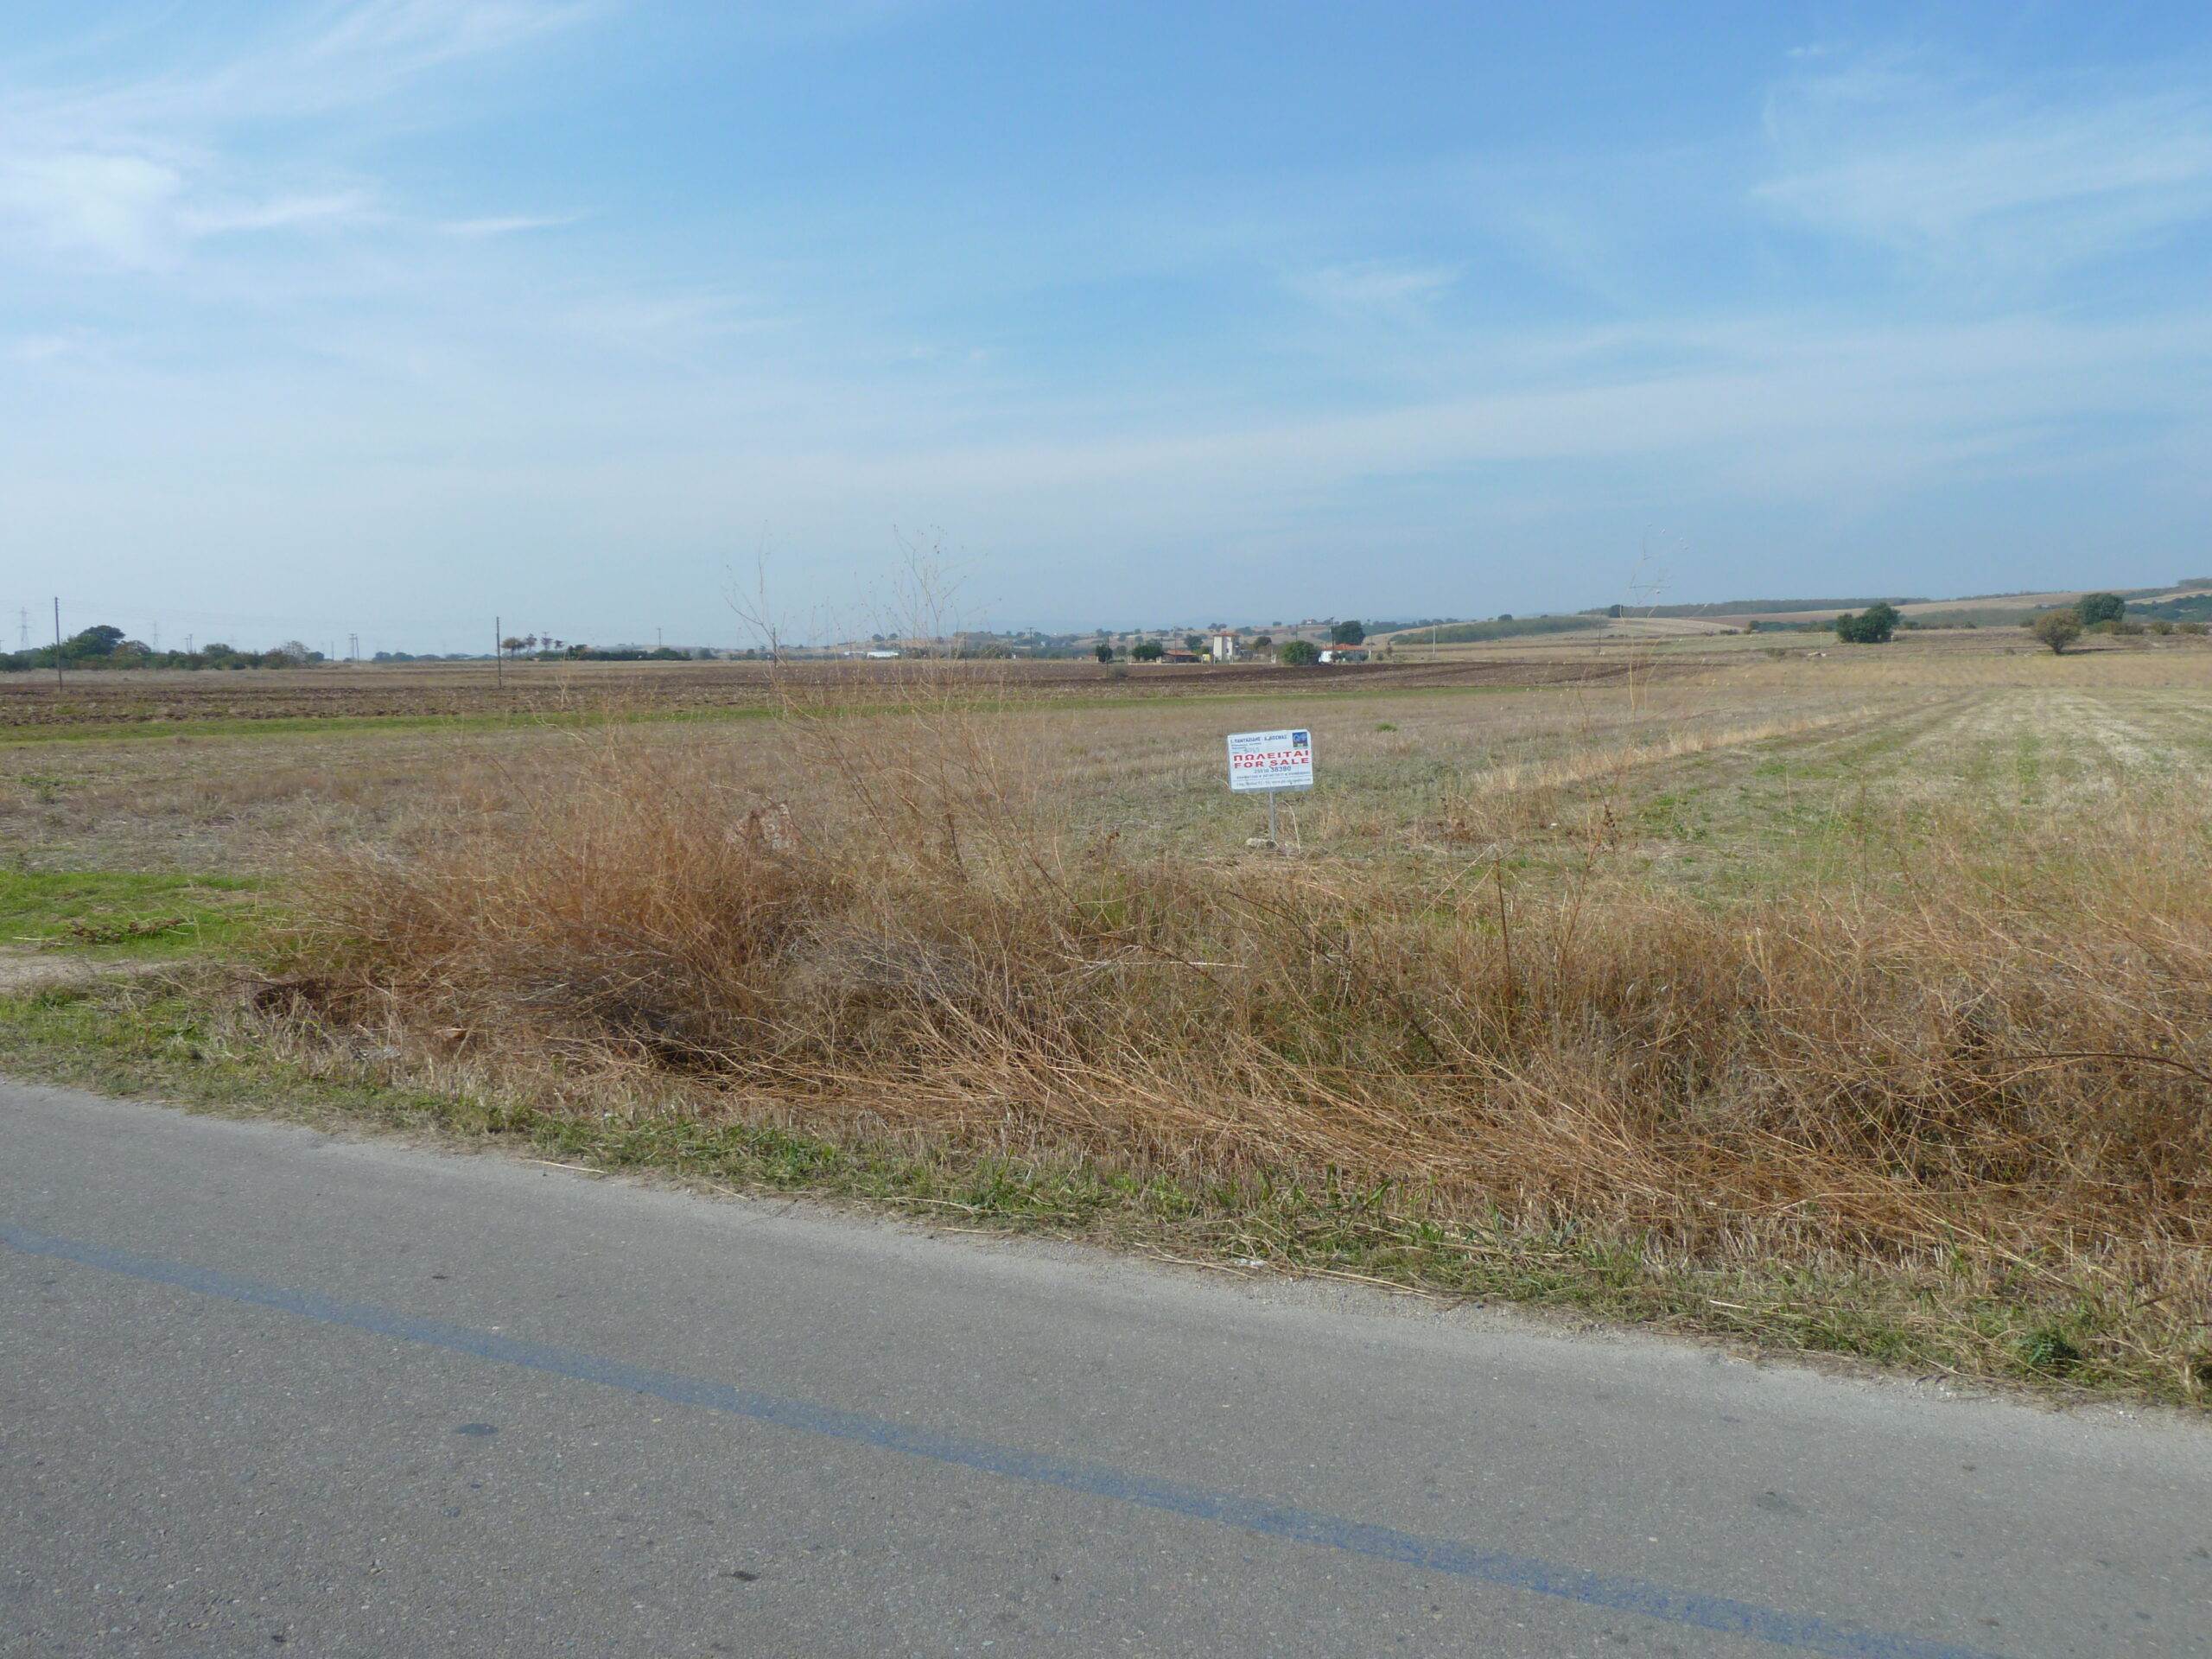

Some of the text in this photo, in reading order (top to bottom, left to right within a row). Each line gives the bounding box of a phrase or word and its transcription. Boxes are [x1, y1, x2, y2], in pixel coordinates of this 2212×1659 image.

[1234, 750, 1309, 761] ΠΩΛΕΙΤΑΙ
[1234, 758, 1309, 769] FOR SALE
